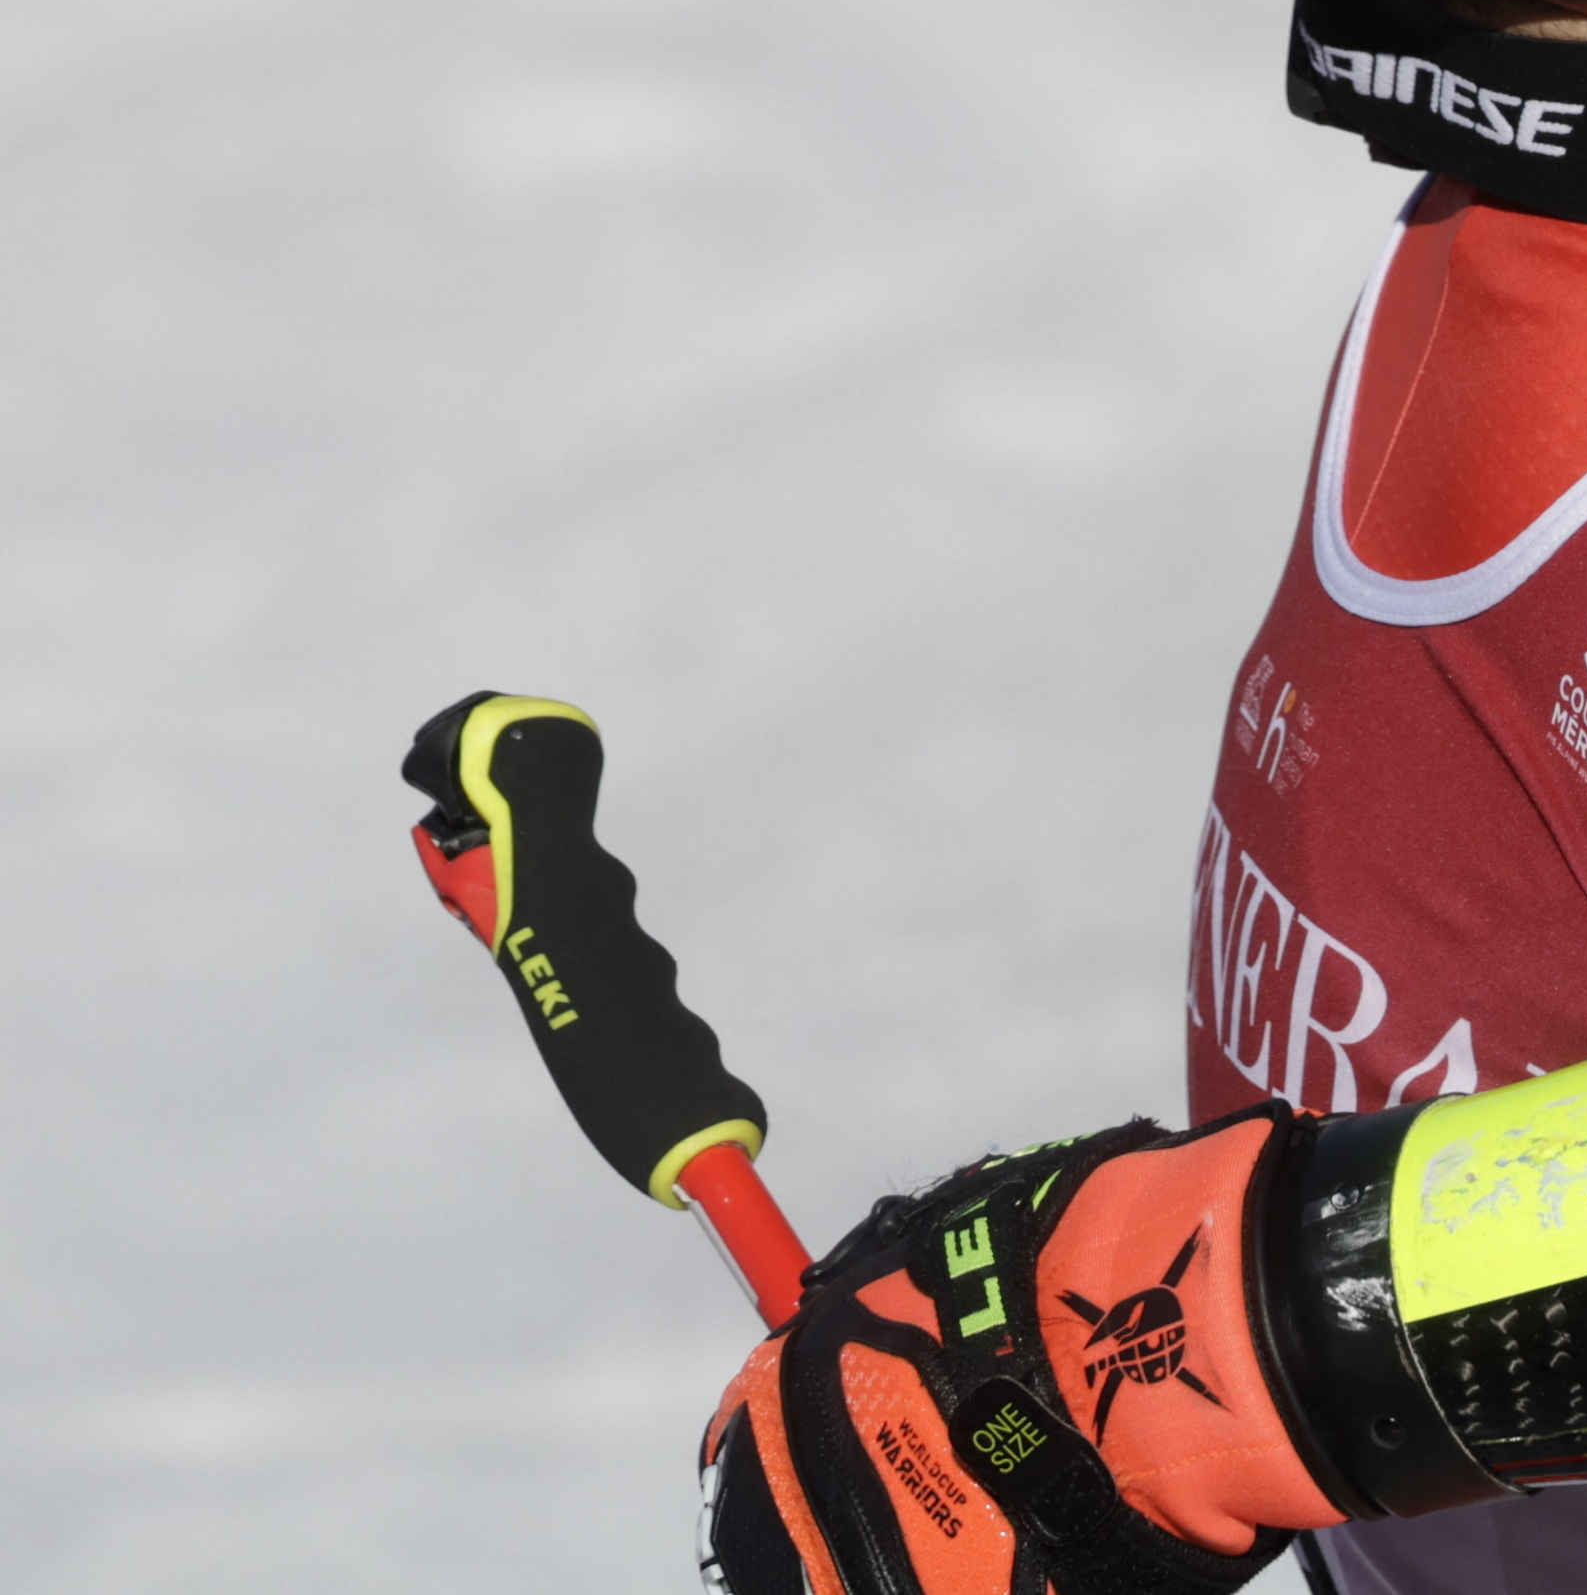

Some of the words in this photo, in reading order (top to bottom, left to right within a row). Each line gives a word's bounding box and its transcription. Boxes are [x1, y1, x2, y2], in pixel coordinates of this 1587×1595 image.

[505, 926, 579, 1031] LEKI
[1187, 802, 1547, 1112] NER
[944, 1198, 1007, 1338] LE
[876, 1420, 963, 1538] WARRIORS
[973, 1402, 1027, 1453] ONE
[991, 1422, 1047, 1473] SIZE
